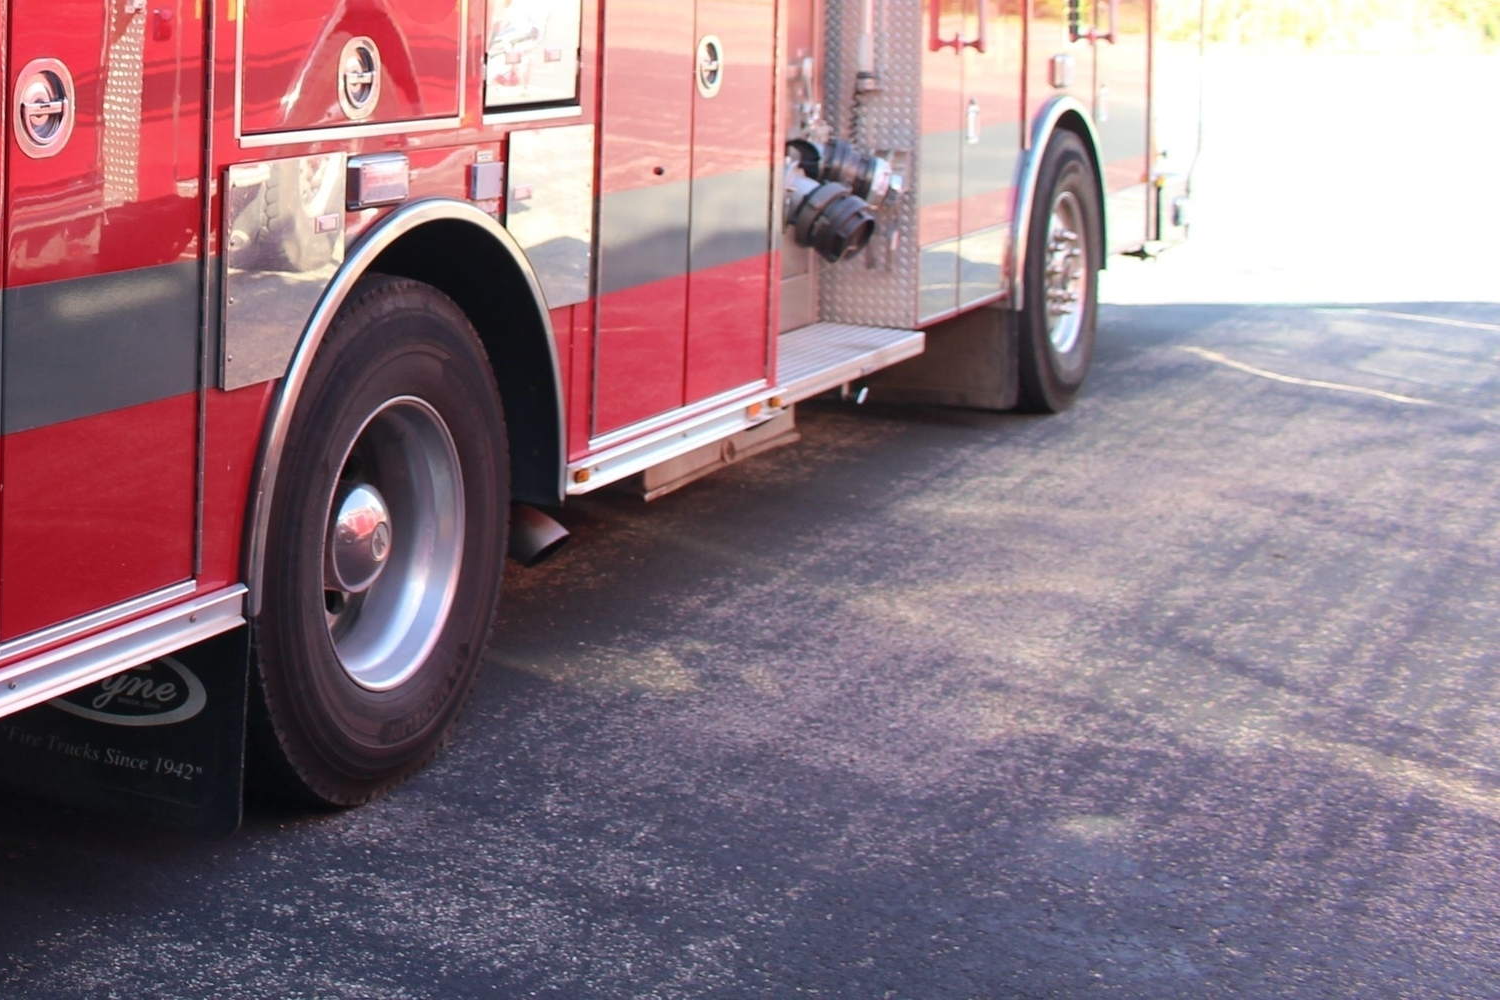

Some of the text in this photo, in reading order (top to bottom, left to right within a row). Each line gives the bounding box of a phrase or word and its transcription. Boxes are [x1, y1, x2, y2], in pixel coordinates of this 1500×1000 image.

[1, 724, 203, 780] "Fire Trucks Since 1942"
